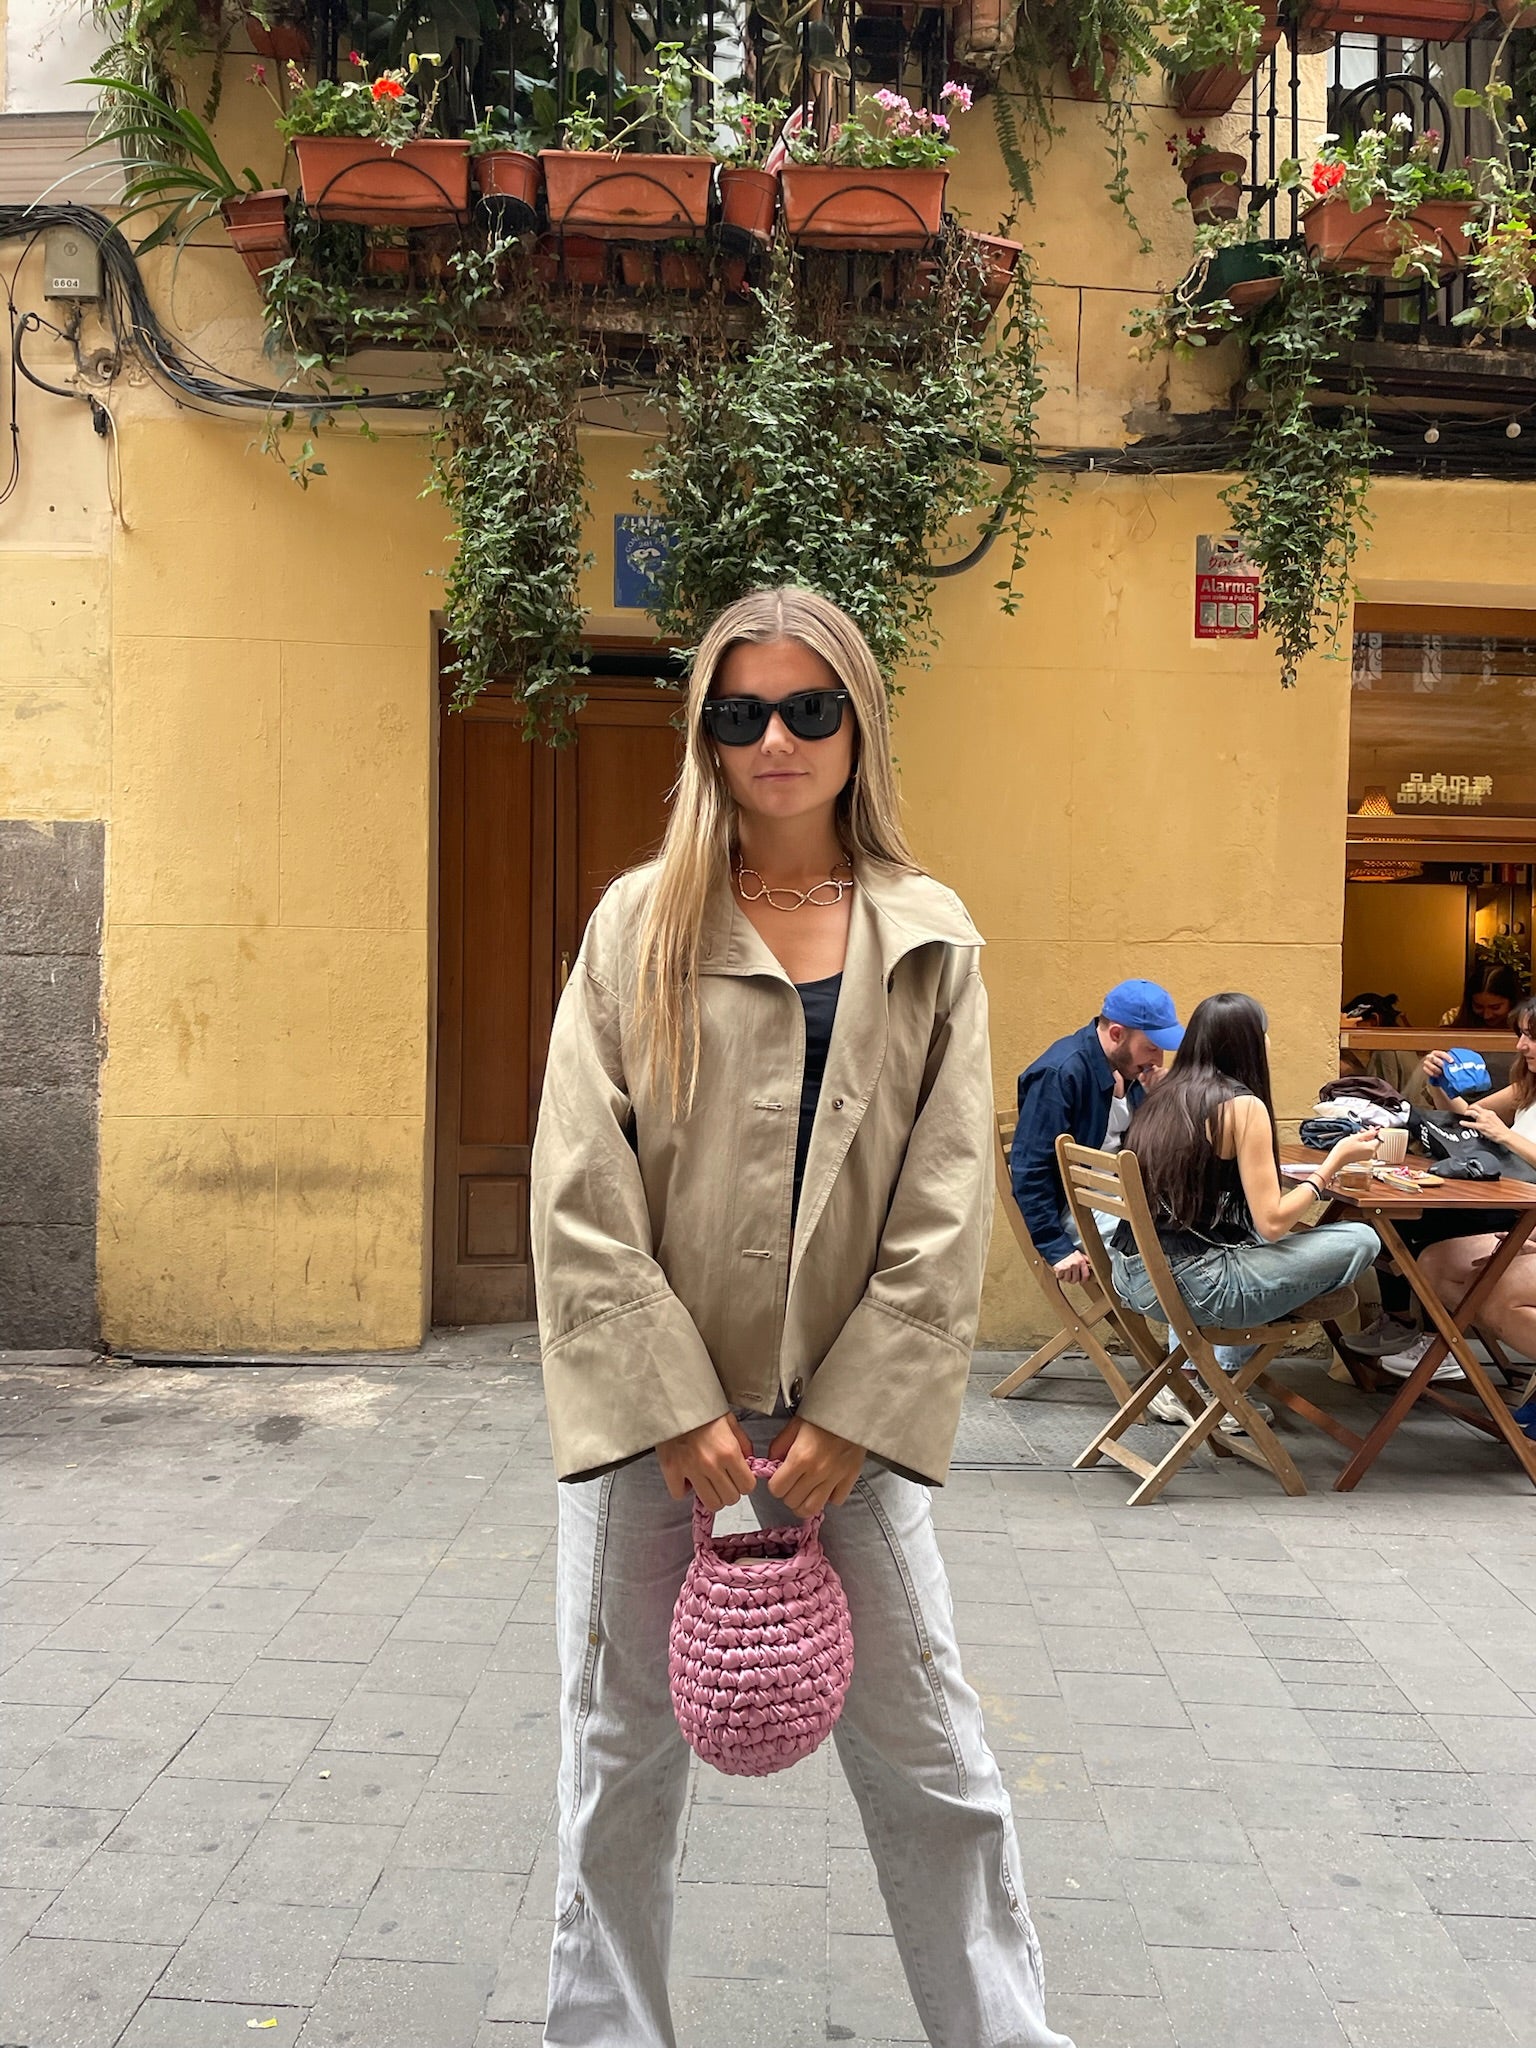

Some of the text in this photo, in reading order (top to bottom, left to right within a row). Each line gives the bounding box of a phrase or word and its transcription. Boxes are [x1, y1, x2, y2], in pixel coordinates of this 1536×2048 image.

[54, 279, 78, 287] 6604
[1200, 578, 1255, 593] Alarma
[1449, 870, 1464, 882] WC
